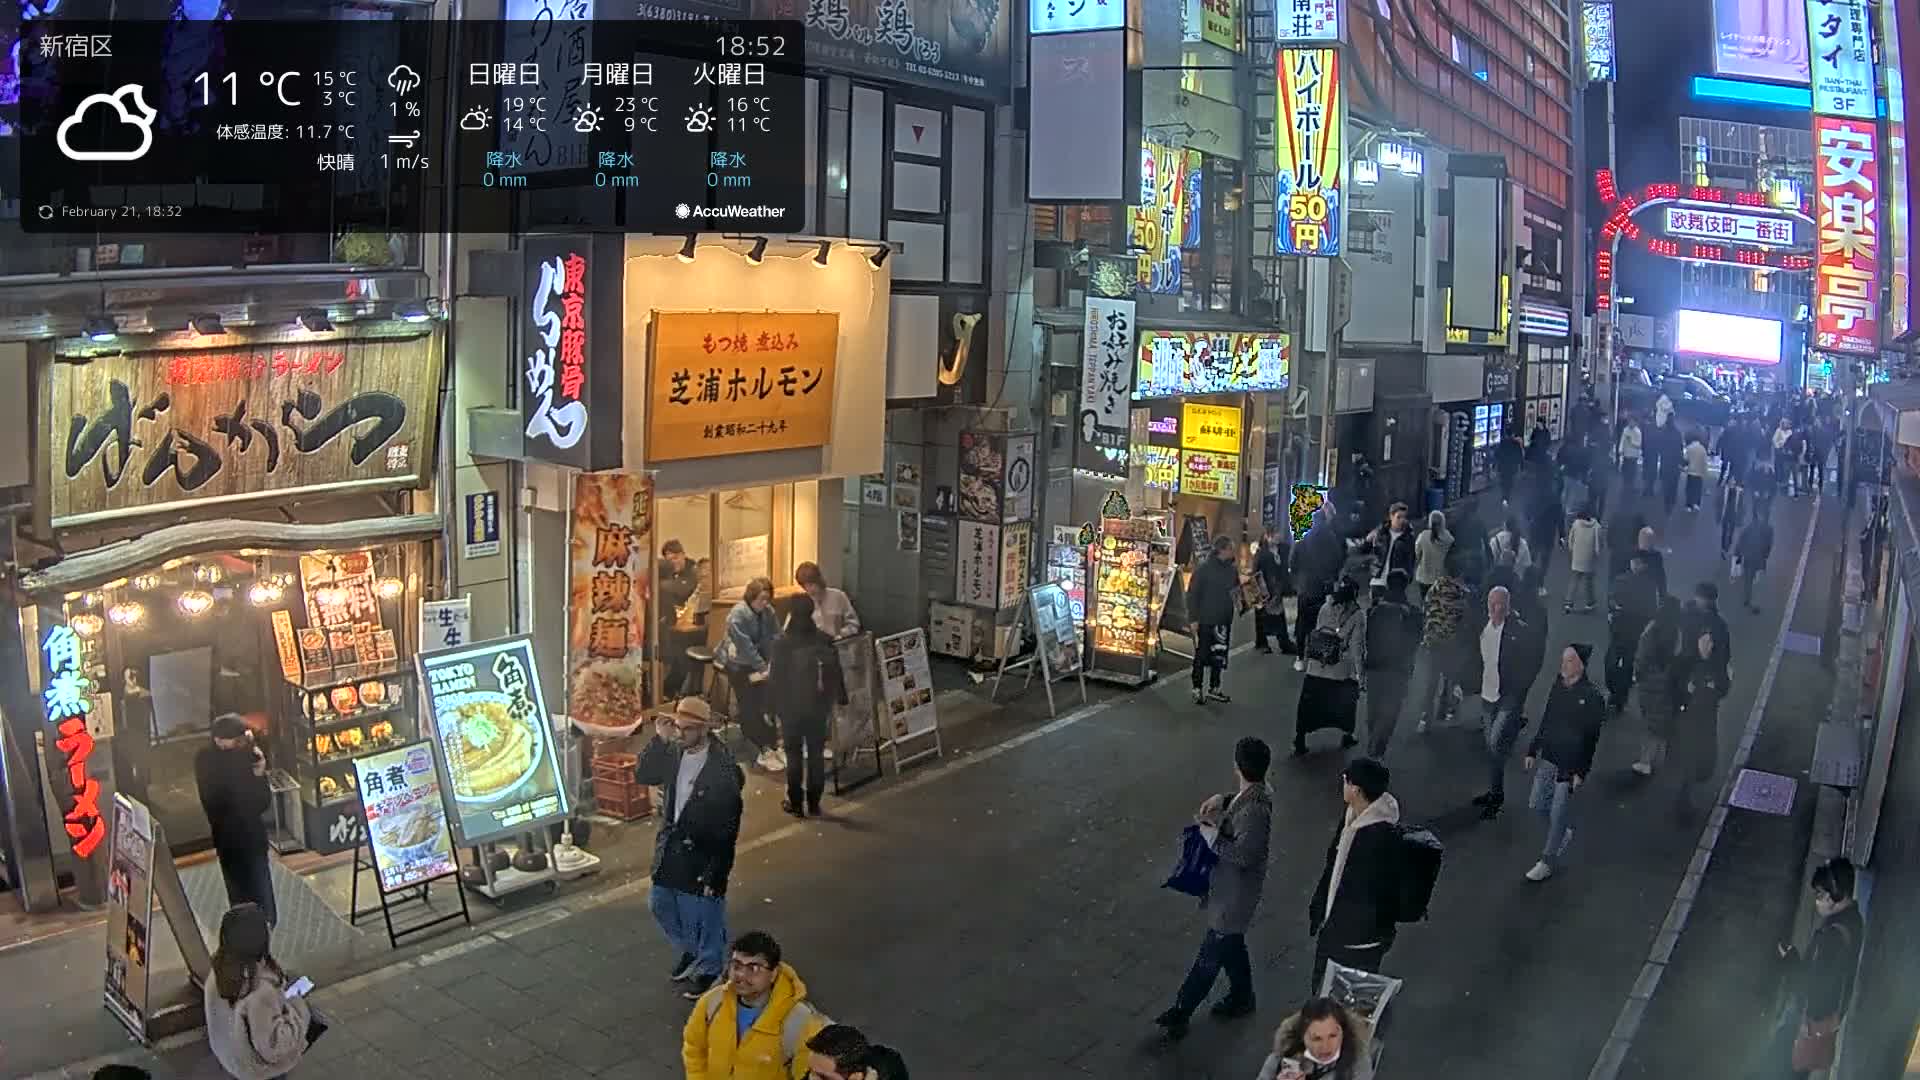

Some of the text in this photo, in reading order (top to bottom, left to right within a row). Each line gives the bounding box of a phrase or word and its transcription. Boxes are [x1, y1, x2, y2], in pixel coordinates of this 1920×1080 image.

[1816, 0, 1843, 70] タイ
[1296, 52, 1323, 190] ハイボール
[1833, 96, 1856, 110] 3F
[1669, 210, 1790, 242] 歌舞伎町一番街
[1818, 126, 1876, 330] 安楽亭
[561, 252, 586, 401] 東京豚骨
[702, 330, 799, 355] もつ焼 煮込み
[1818, 331, 1838, 347] 2F
[1100, 309, 1130, 415] お好み焼き
[668, 366, 823, 405] 芝浦ホルモン
[67, 379, 406, 492] ばんから
[428, 662, 475, 684] TOKYO
[363, 764, 409, 797] 角煮
